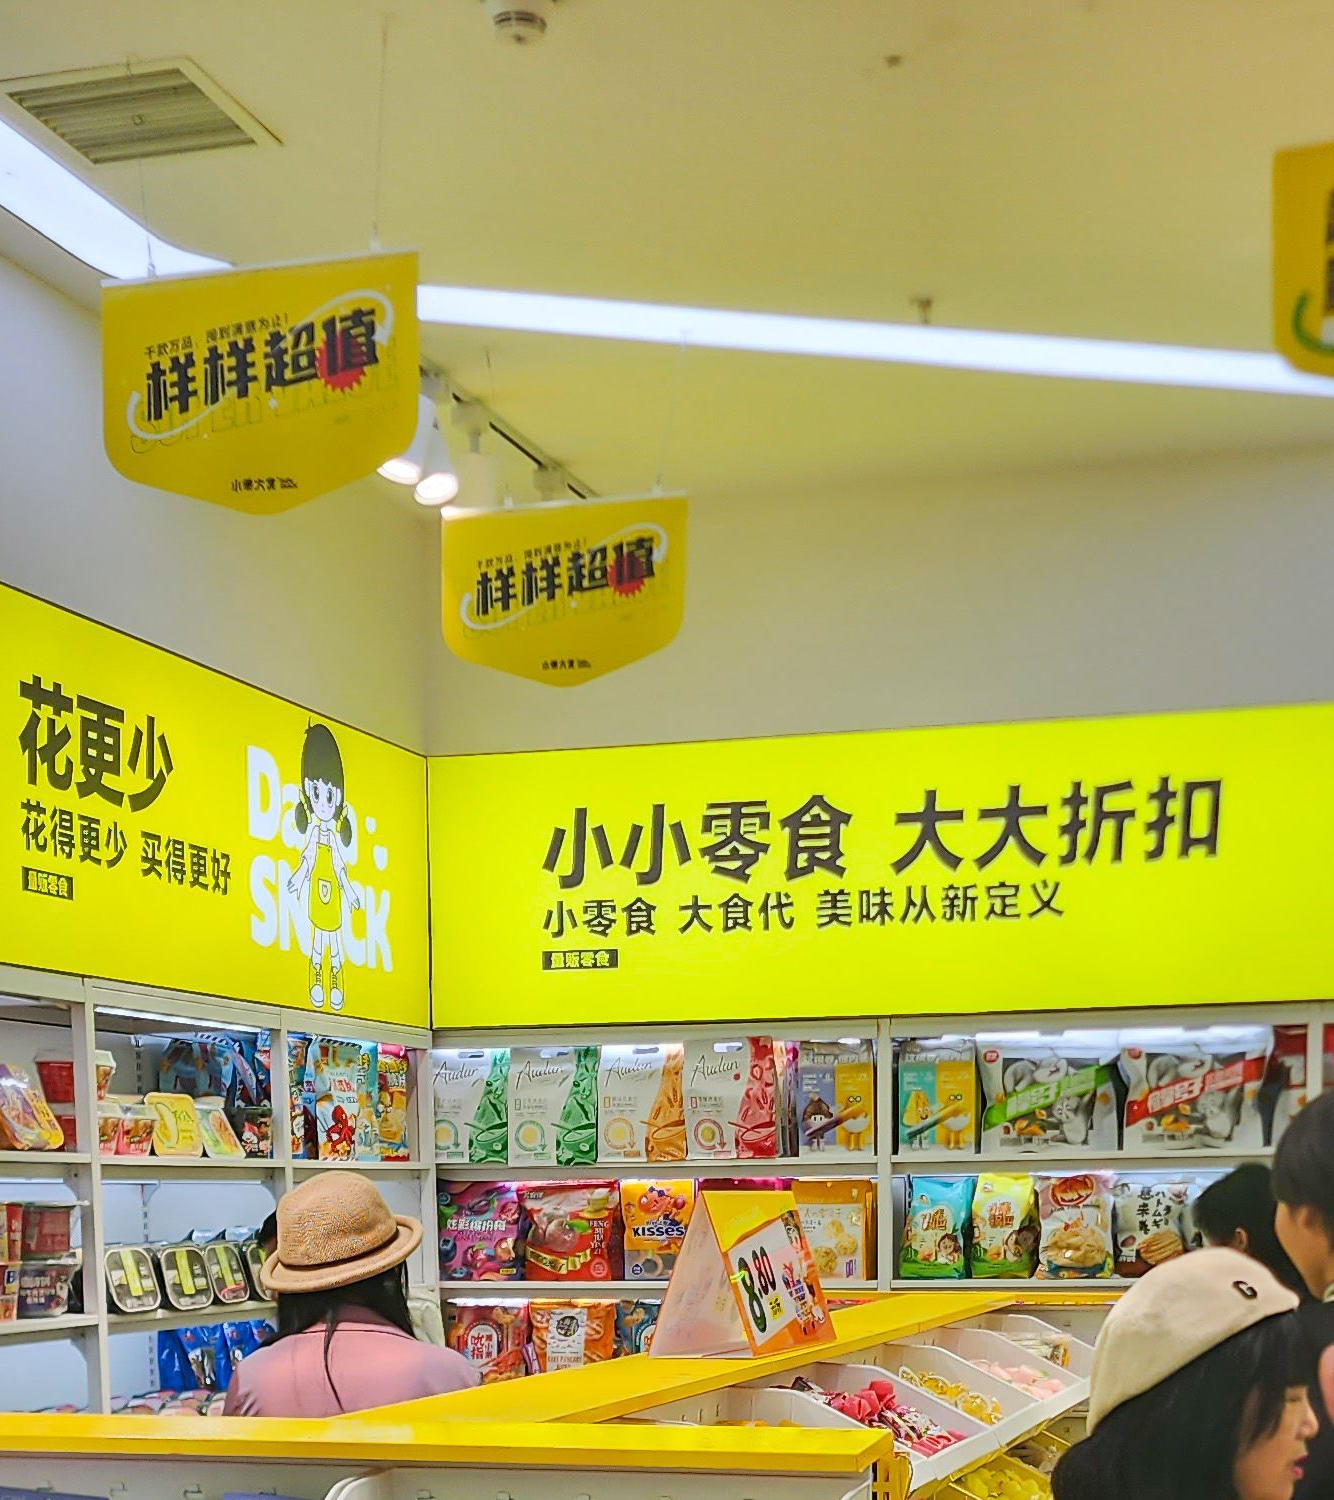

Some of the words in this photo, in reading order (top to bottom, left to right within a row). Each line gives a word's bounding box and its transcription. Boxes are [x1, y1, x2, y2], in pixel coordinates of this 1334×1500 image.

[146, 308, 379, 421] 样样超值
[476, 536, 655, 617] 样样超值
[19, 674, 174, 813] 花更少
[21, 798, 127, 869] 花得更少
[140, 830, 231, 895] 买得更好
[542, 794, 855, 888] 小小零食
[891, 775, 1223, 874] 大大折扣
[250, 854, 393, 973] SNCK
[542, 897, 658, 940] 小零食
[678, 891, 796, 935] 大食代
[815, 879, 1065, 929] 美味从新定义
[632, 1226, 685, 1237] KISSES
[738, 1246, 777, 1333] 8.80
